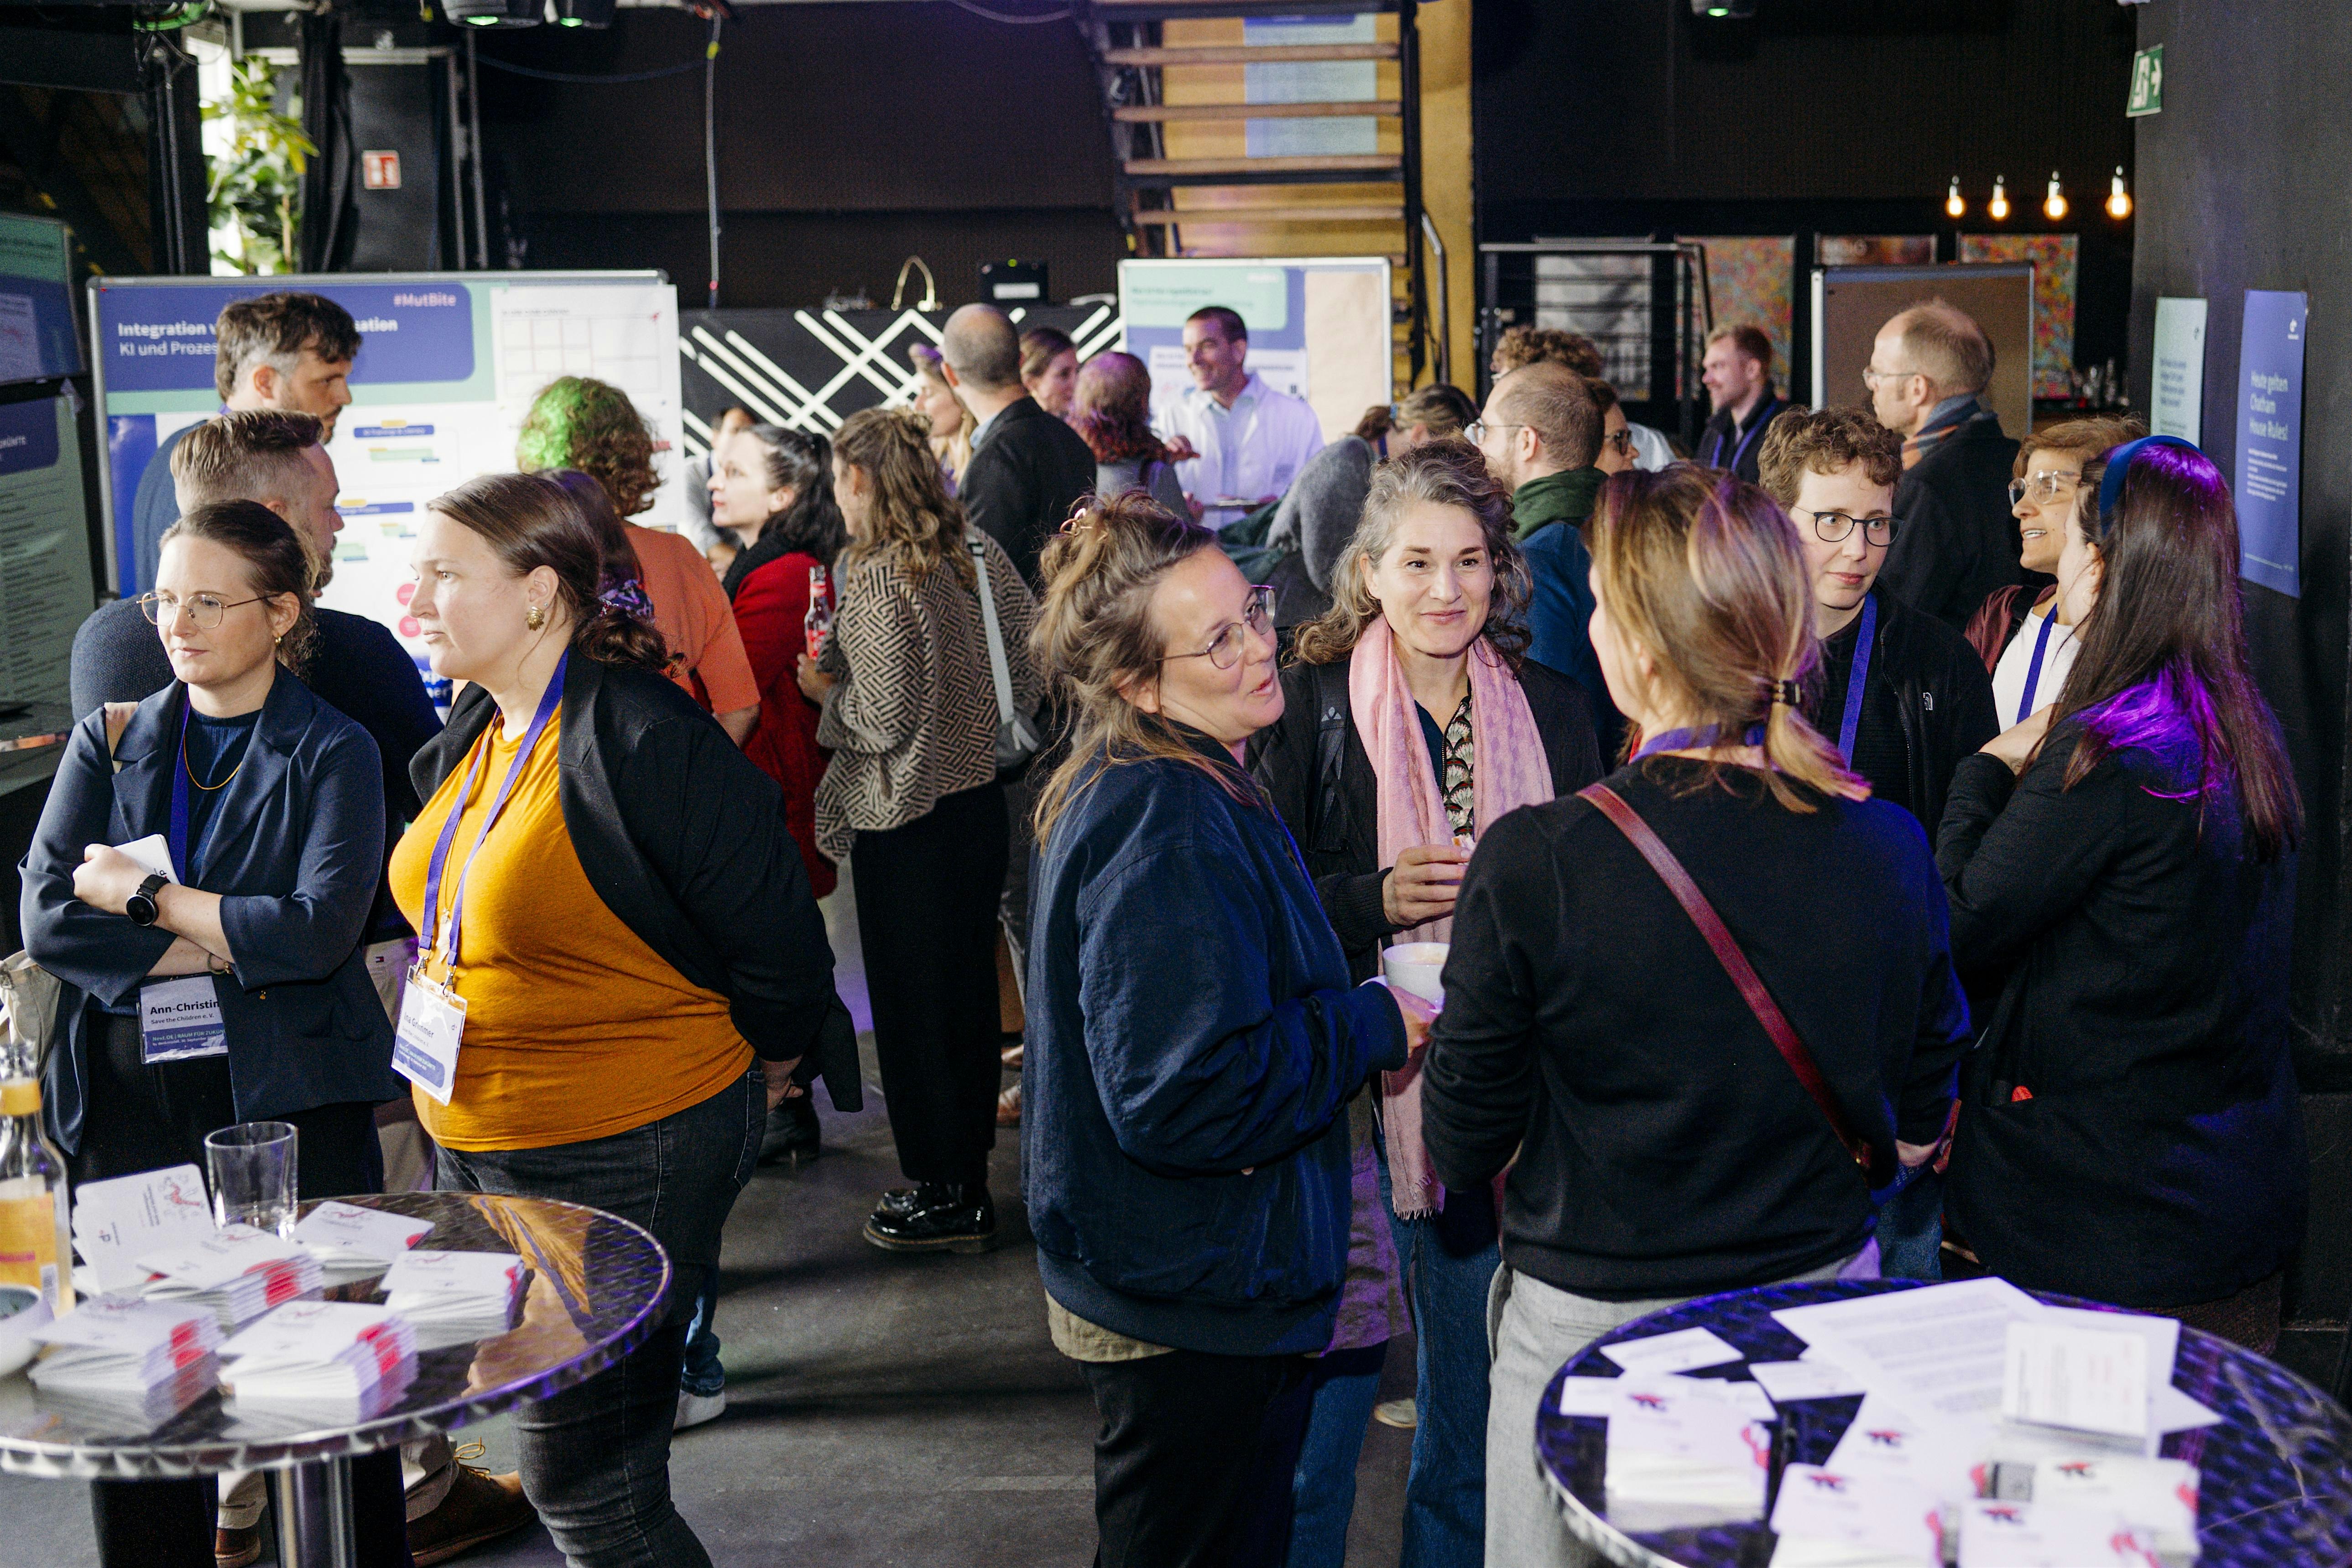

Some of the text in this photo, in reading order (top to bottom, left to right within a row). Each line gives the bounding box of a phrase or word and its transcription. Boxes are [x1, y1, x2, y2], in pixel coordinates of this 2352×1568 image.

[393, 292, 456, 307] #MutBite
[118, 320, 207, 339] Integration
[120, 341, 217, 356] KI und Prozes
[150, 1000, 219, 1015] Ann-Christin
